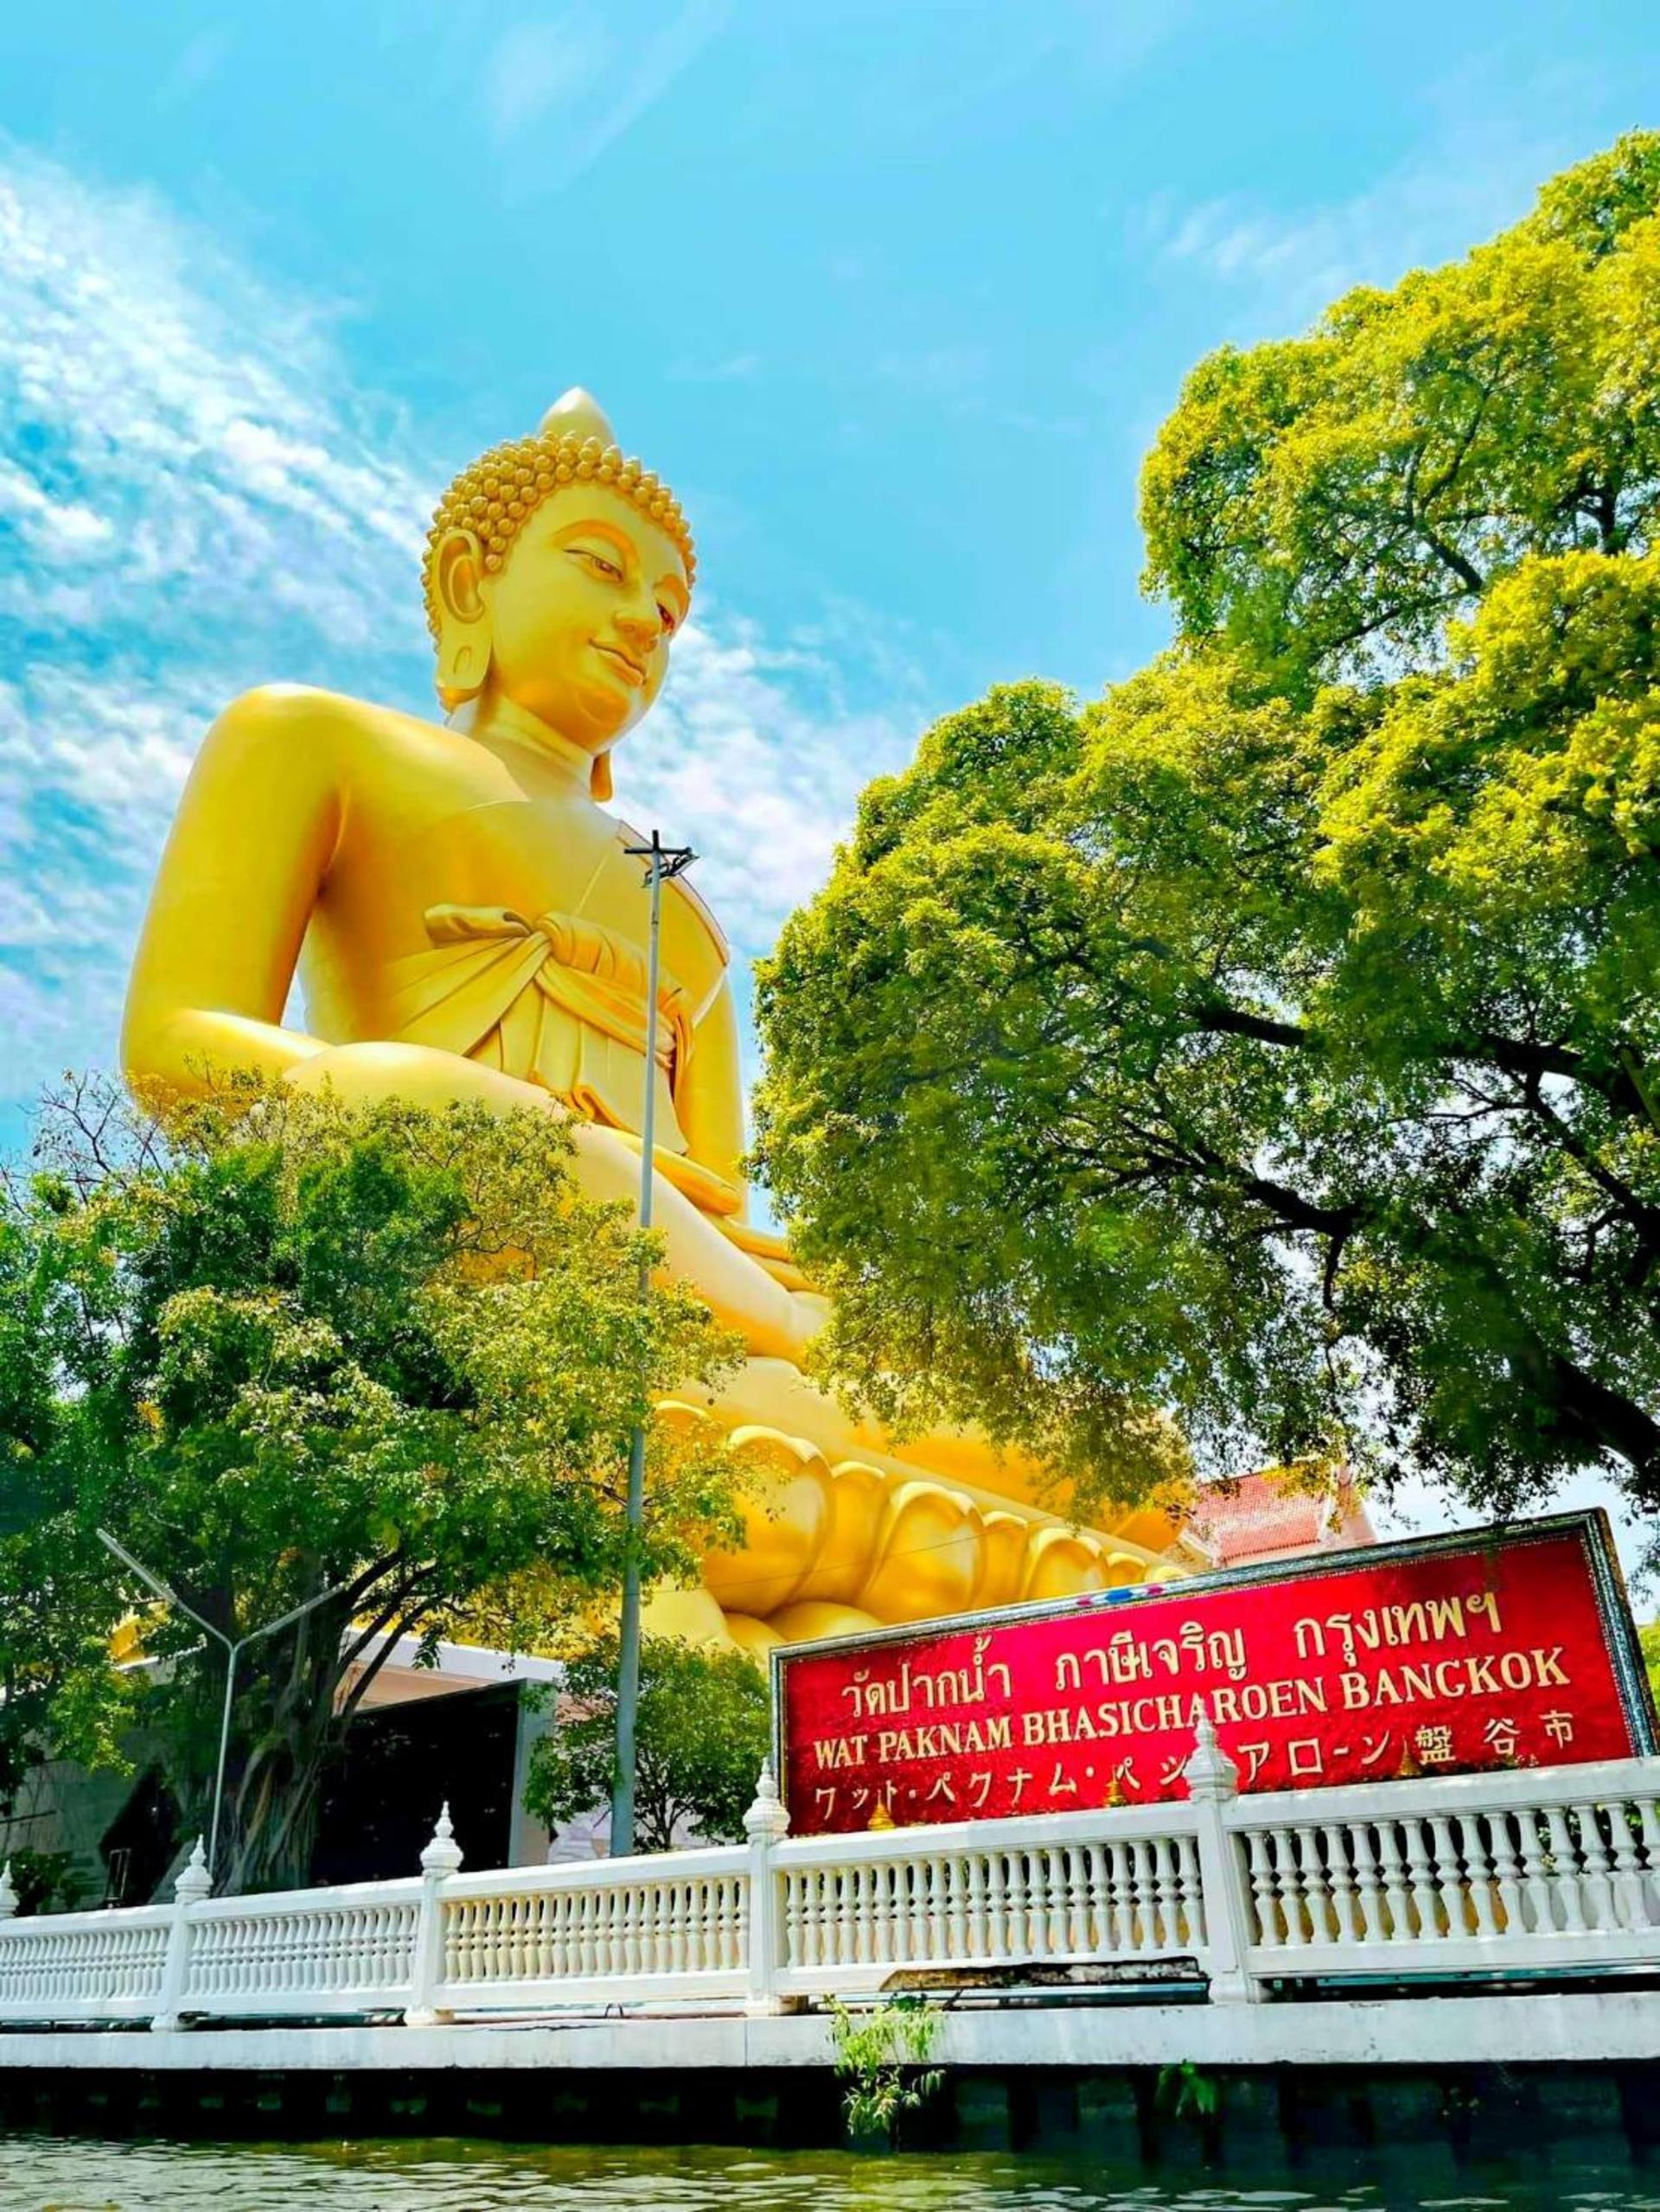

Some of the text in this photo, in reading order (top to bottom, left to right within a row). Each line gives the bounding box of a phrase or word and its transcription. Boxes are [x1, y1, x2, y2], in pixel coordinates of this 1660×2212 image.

[814, 1646, 1571, 1769] WAT PAKNAM BHASICHAROEN BANGKOK
[841, 1591, 1502, 1718] วัดปากน้ำ ภาษีเจริญ กรุงเทพฯ
